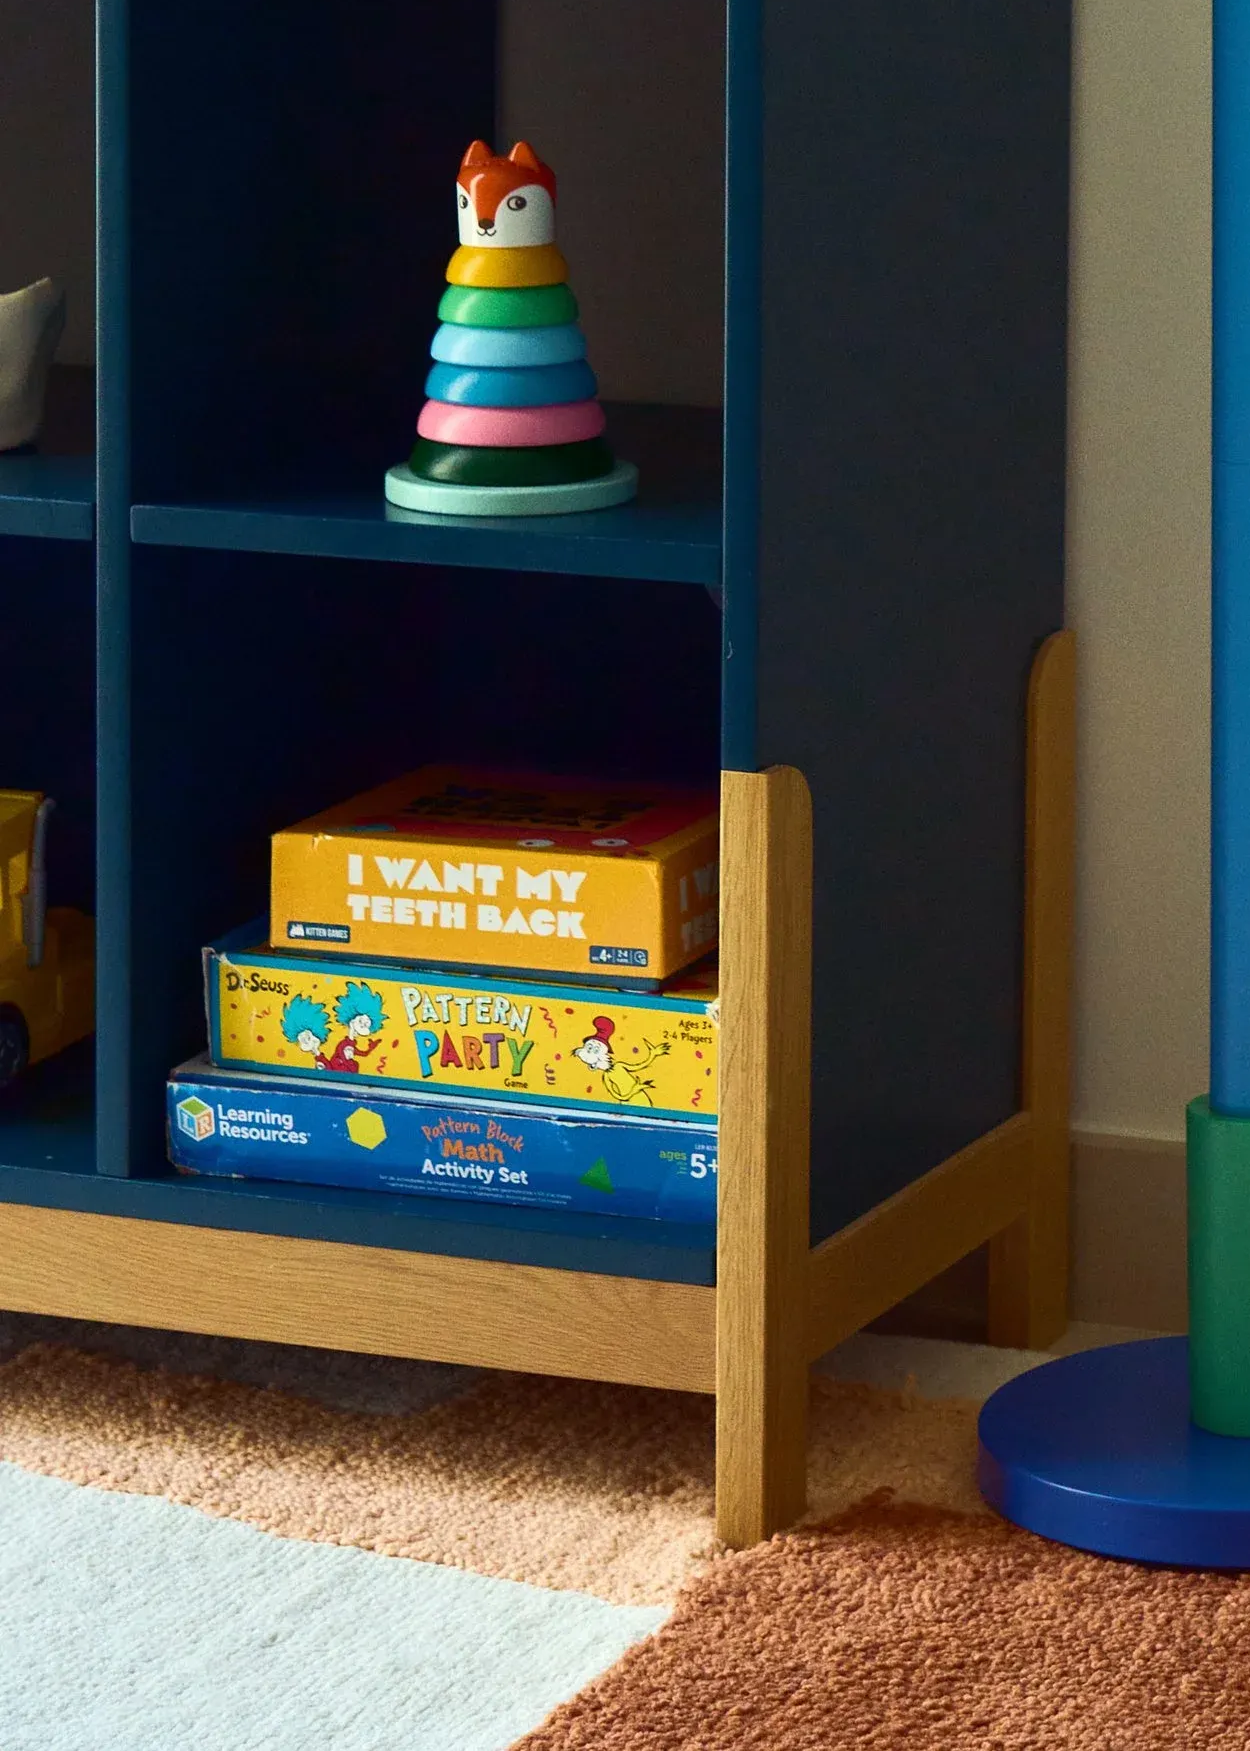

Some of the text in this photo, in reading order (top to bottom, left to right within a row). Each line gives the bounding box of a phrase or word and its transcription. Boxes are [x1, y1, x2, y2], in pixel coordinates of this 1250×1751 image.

[347, 854, 587, 903] I WANT MY
[346, 893, 587, 939] TEETH BACK
[400, 986, 533, 1037] PATTERN
[679, 1020, 699, 1031] Ages
[681, 1032, 713, 1045] Players
[414, 1030, 534, 1078] PARTY
[504, 1078, 529, 1089] Game
[217, 1104, 293, 1130] Learning
[219, 1121, 308, 1144] Resources
[486, 1119, 524, 1153] Block
[441, 1138, 505, 1164] Math
[659, 1150, 687, 1161] ages
[421, 1158, 529, 1185] Activity Set
[690, 1153, 718, 1179] 5+
